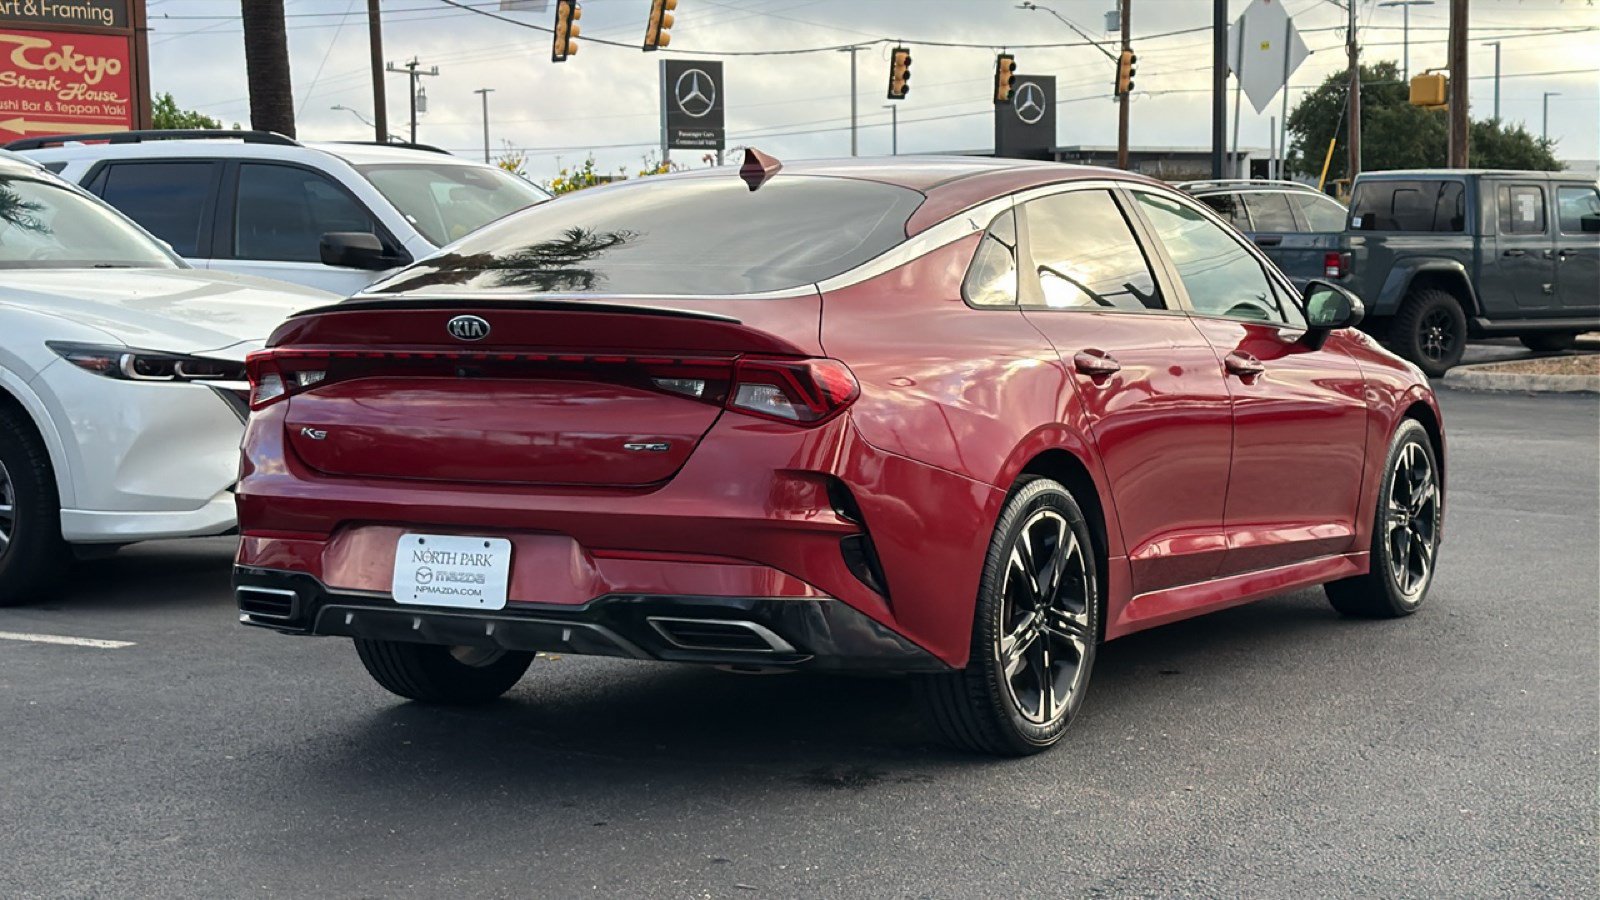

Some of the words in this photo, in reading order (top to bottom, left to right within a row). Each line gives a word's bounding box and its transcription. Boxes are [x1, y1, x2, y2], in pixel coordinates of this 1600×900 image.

[23, 0, 39, 16] &
[41, 0, 115, 26] Framing
[0, 33, 122, 85] Tokyo
[0, 70, 61, 91] Steak
[57, 83, 128, 103] House
[21, 100, 41, 111] Bar
[44, 101, 53, 112] &
[56, 101, 100, 115] Teppan
[102, 104, 126, 115] Yaki
[453, 320, 484, 337] KIA
[300, 427, 328, 440] K5
[412, 548, 458, 566] NORTH
[459, 552, 494, 567] PARK
[435, 570, 486, 585] mazda
[415, 585, 482, 597] NPMAZDA.COM
